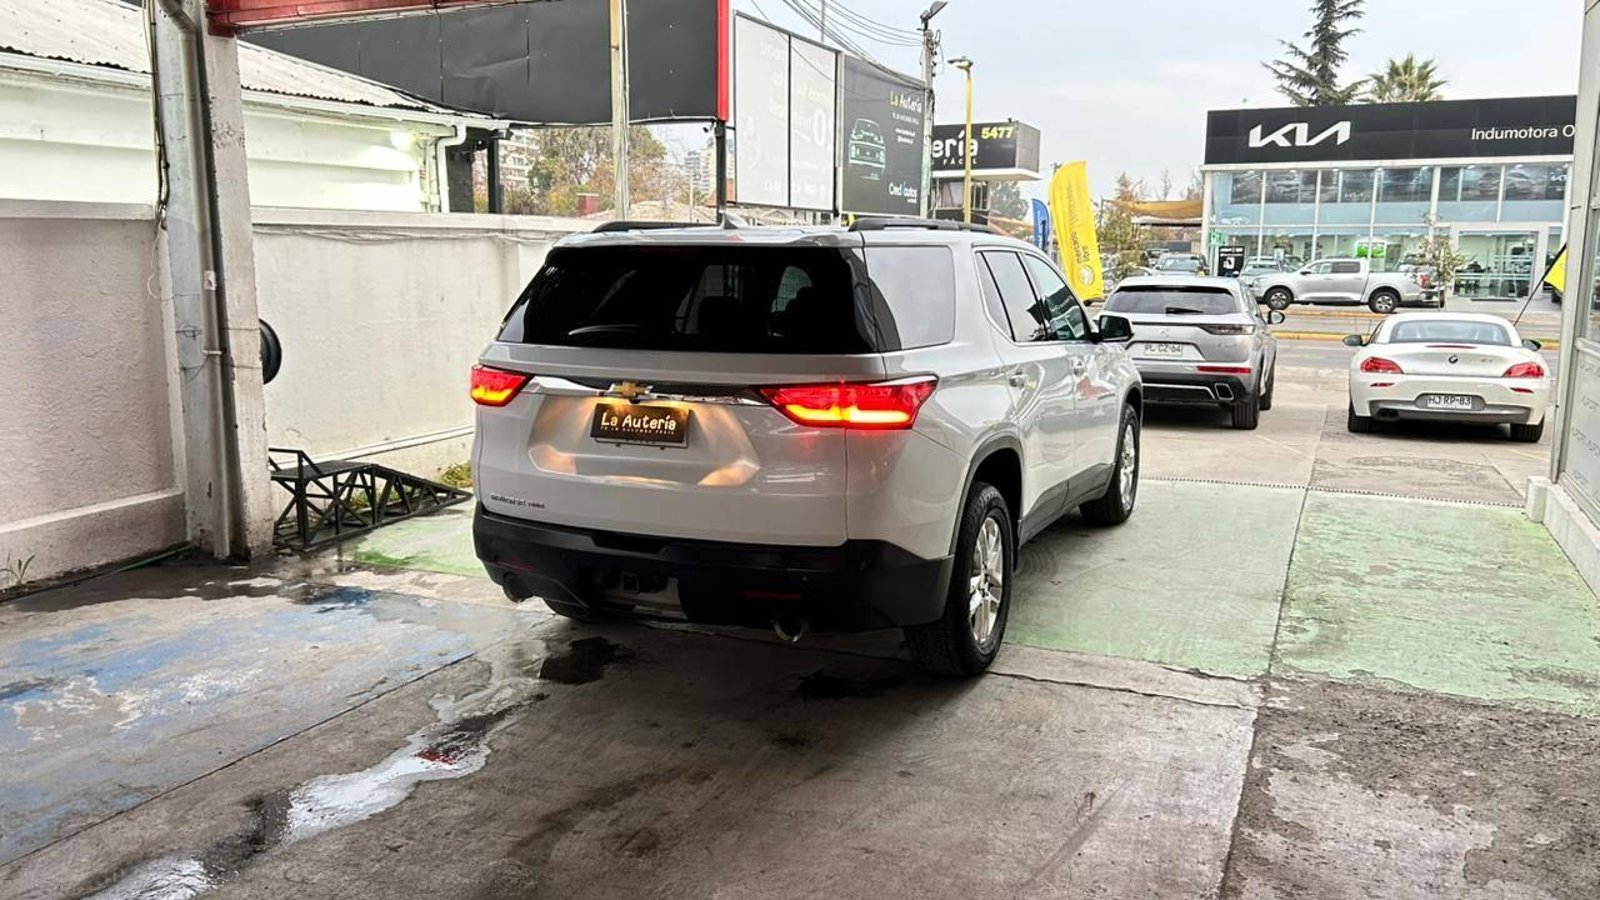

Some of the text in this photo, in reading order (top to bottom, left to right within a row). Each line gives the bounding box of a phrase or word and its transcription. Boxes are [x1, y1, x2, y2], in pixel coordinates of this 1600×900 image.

[889, 90, 899, 106] La
[981, 126, 1014, 139] 5477
[1248, 120, 1351, 148] KIA
[1471, 127, 1558, 140] Indumotora
[601, 411, 619, 427] La
[621, 414, 677, 431] Autería
